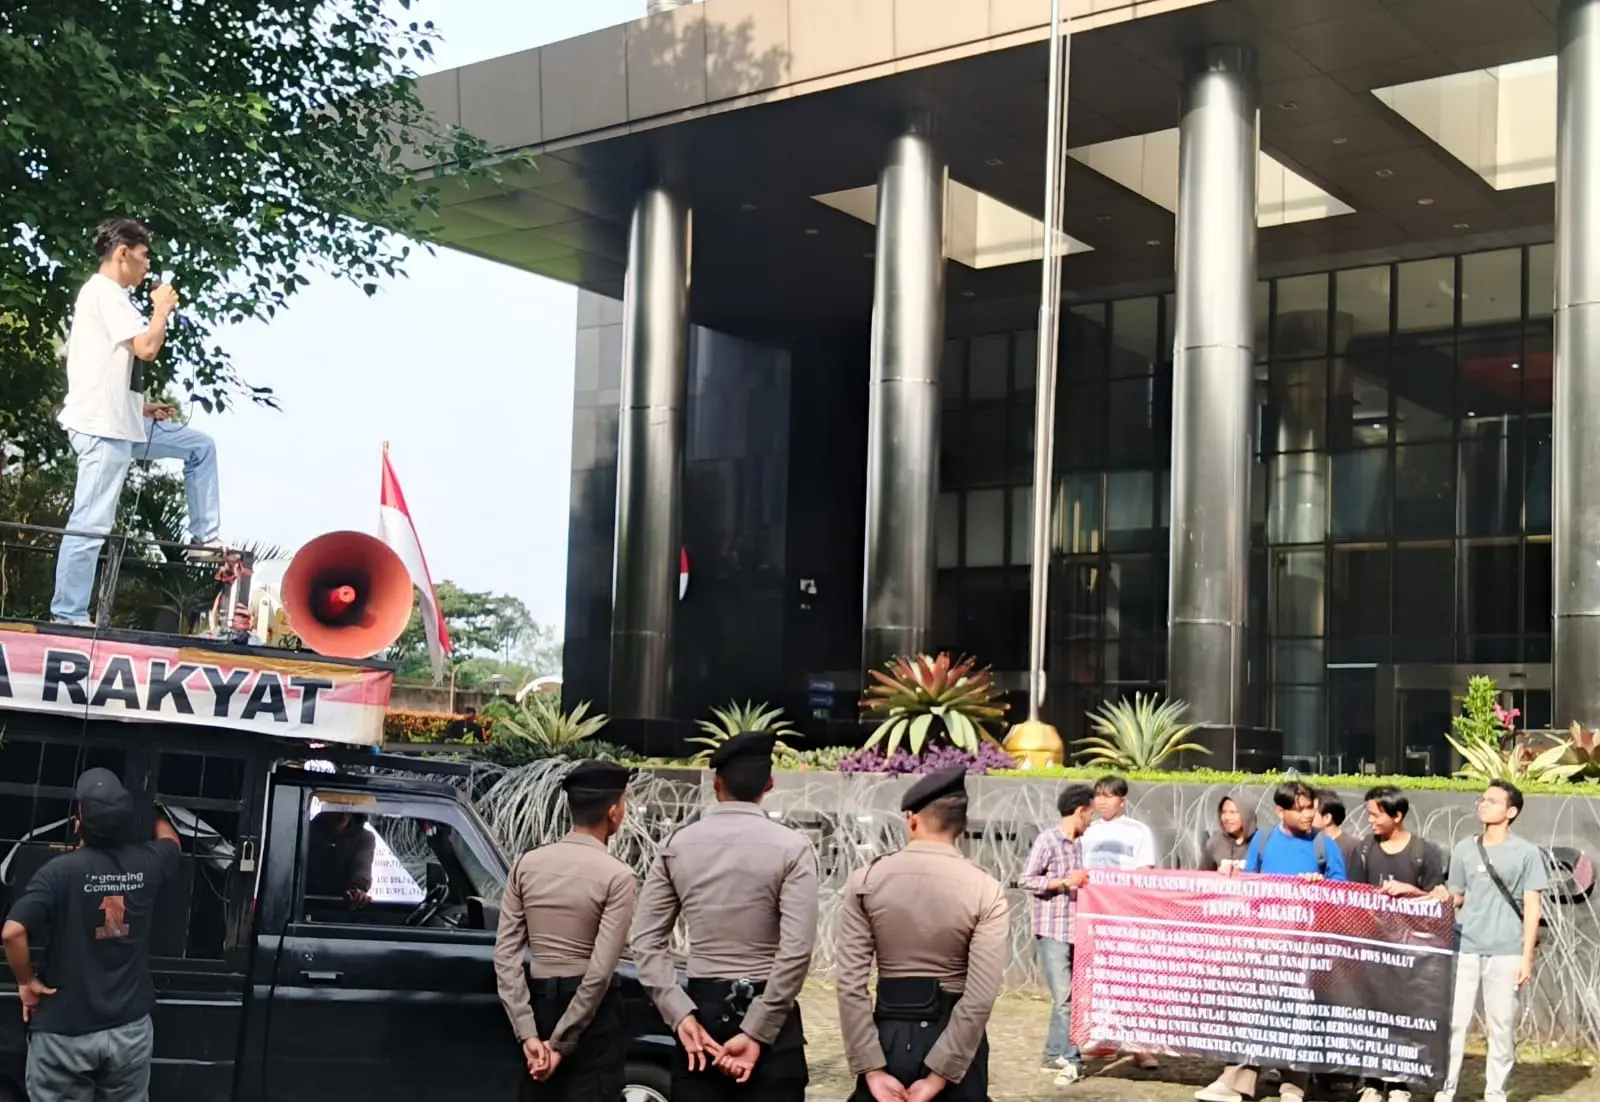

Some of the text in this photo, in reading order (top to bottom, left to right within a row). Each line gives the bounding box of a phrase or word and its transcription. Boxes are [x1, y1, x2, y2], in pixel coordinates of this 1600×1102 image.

[41, 648, 333, 725] RAKYAT
[1258, 902, 1308, 924] JAKARTA
[1261, 881, 1345, 905] PEMBANGUNAN
[1348, 890, 1442, 919] MALUT-JAKARTA
[1245, 951, 1262, 965] PPK
[1264, 953, 1279, 966] AIR
[1281, 955, 1308, 969] TANAH
[1310, 957, 1332, 971] BATU
[1257, 937, 1322, 955] MENGEVALUASI
[1324, 943, 1359, 959] KEPALA
[1360, 948, 1380, 962] BWS
[1382, 952, 1415, 967] MALUT
[1203, 978, 1257, 994] MEMANGGIL
[1260, 983, 1278, 996] DAN
[1280, 985, 1315, 1001] PERIKSA
[1253, 968, 1306, 983] MUHAMMAD
[1198, 1007, 1225, 1021] PULAU
[1228, 1010, 1268, 1026] MOROTAI
[1269, 1015, 1291, 1029] YANG
[1293, 1017, 1325, 1033] DIDUGA
[1327, 1020, 1389, 1039] BERMASALAH
[1201, 992, 1215, 1005] EDI
[1217, 994, 1263, 1010] SUKIRMAN
[1264, 999, 1294, 1014] DALAM
[1296, 1002, 1330, 1017] PROYEK
[1332, 1005, 1366, 1021] IRIGASI
[1368, 1010, 1395, 1025] WEDA
[1395, 1014, 1437, 1032] SELATAN
[1139, 1016, 1157, 1029] KPK
[1158, 1018, 1167, 1030] RI
[1168, 1018, 1198, 1033] UNTUK
[1200, 1021, 1234, 1037] SEGERA
[1235, 1026, 1288, 1044] MENELUSURI
[1289, 1032, 1323, 1048] PROYEK
[1325, 1035, 1364, 1051] EMBUNG
[1365, 1040, 1396, 1055] PULAU
[1398, 1044, 1418, 1059] HIRI
[1187, 1035, 1231, 1052] DIREKTUR
[1271, 1045, 1296, 1061] PUTRI
[1297, 1048, 1324, 1064] SERTA
[1326, 1050, 1345, 1065] PPK
[1363, 1054, 1379, 1069] EDI
